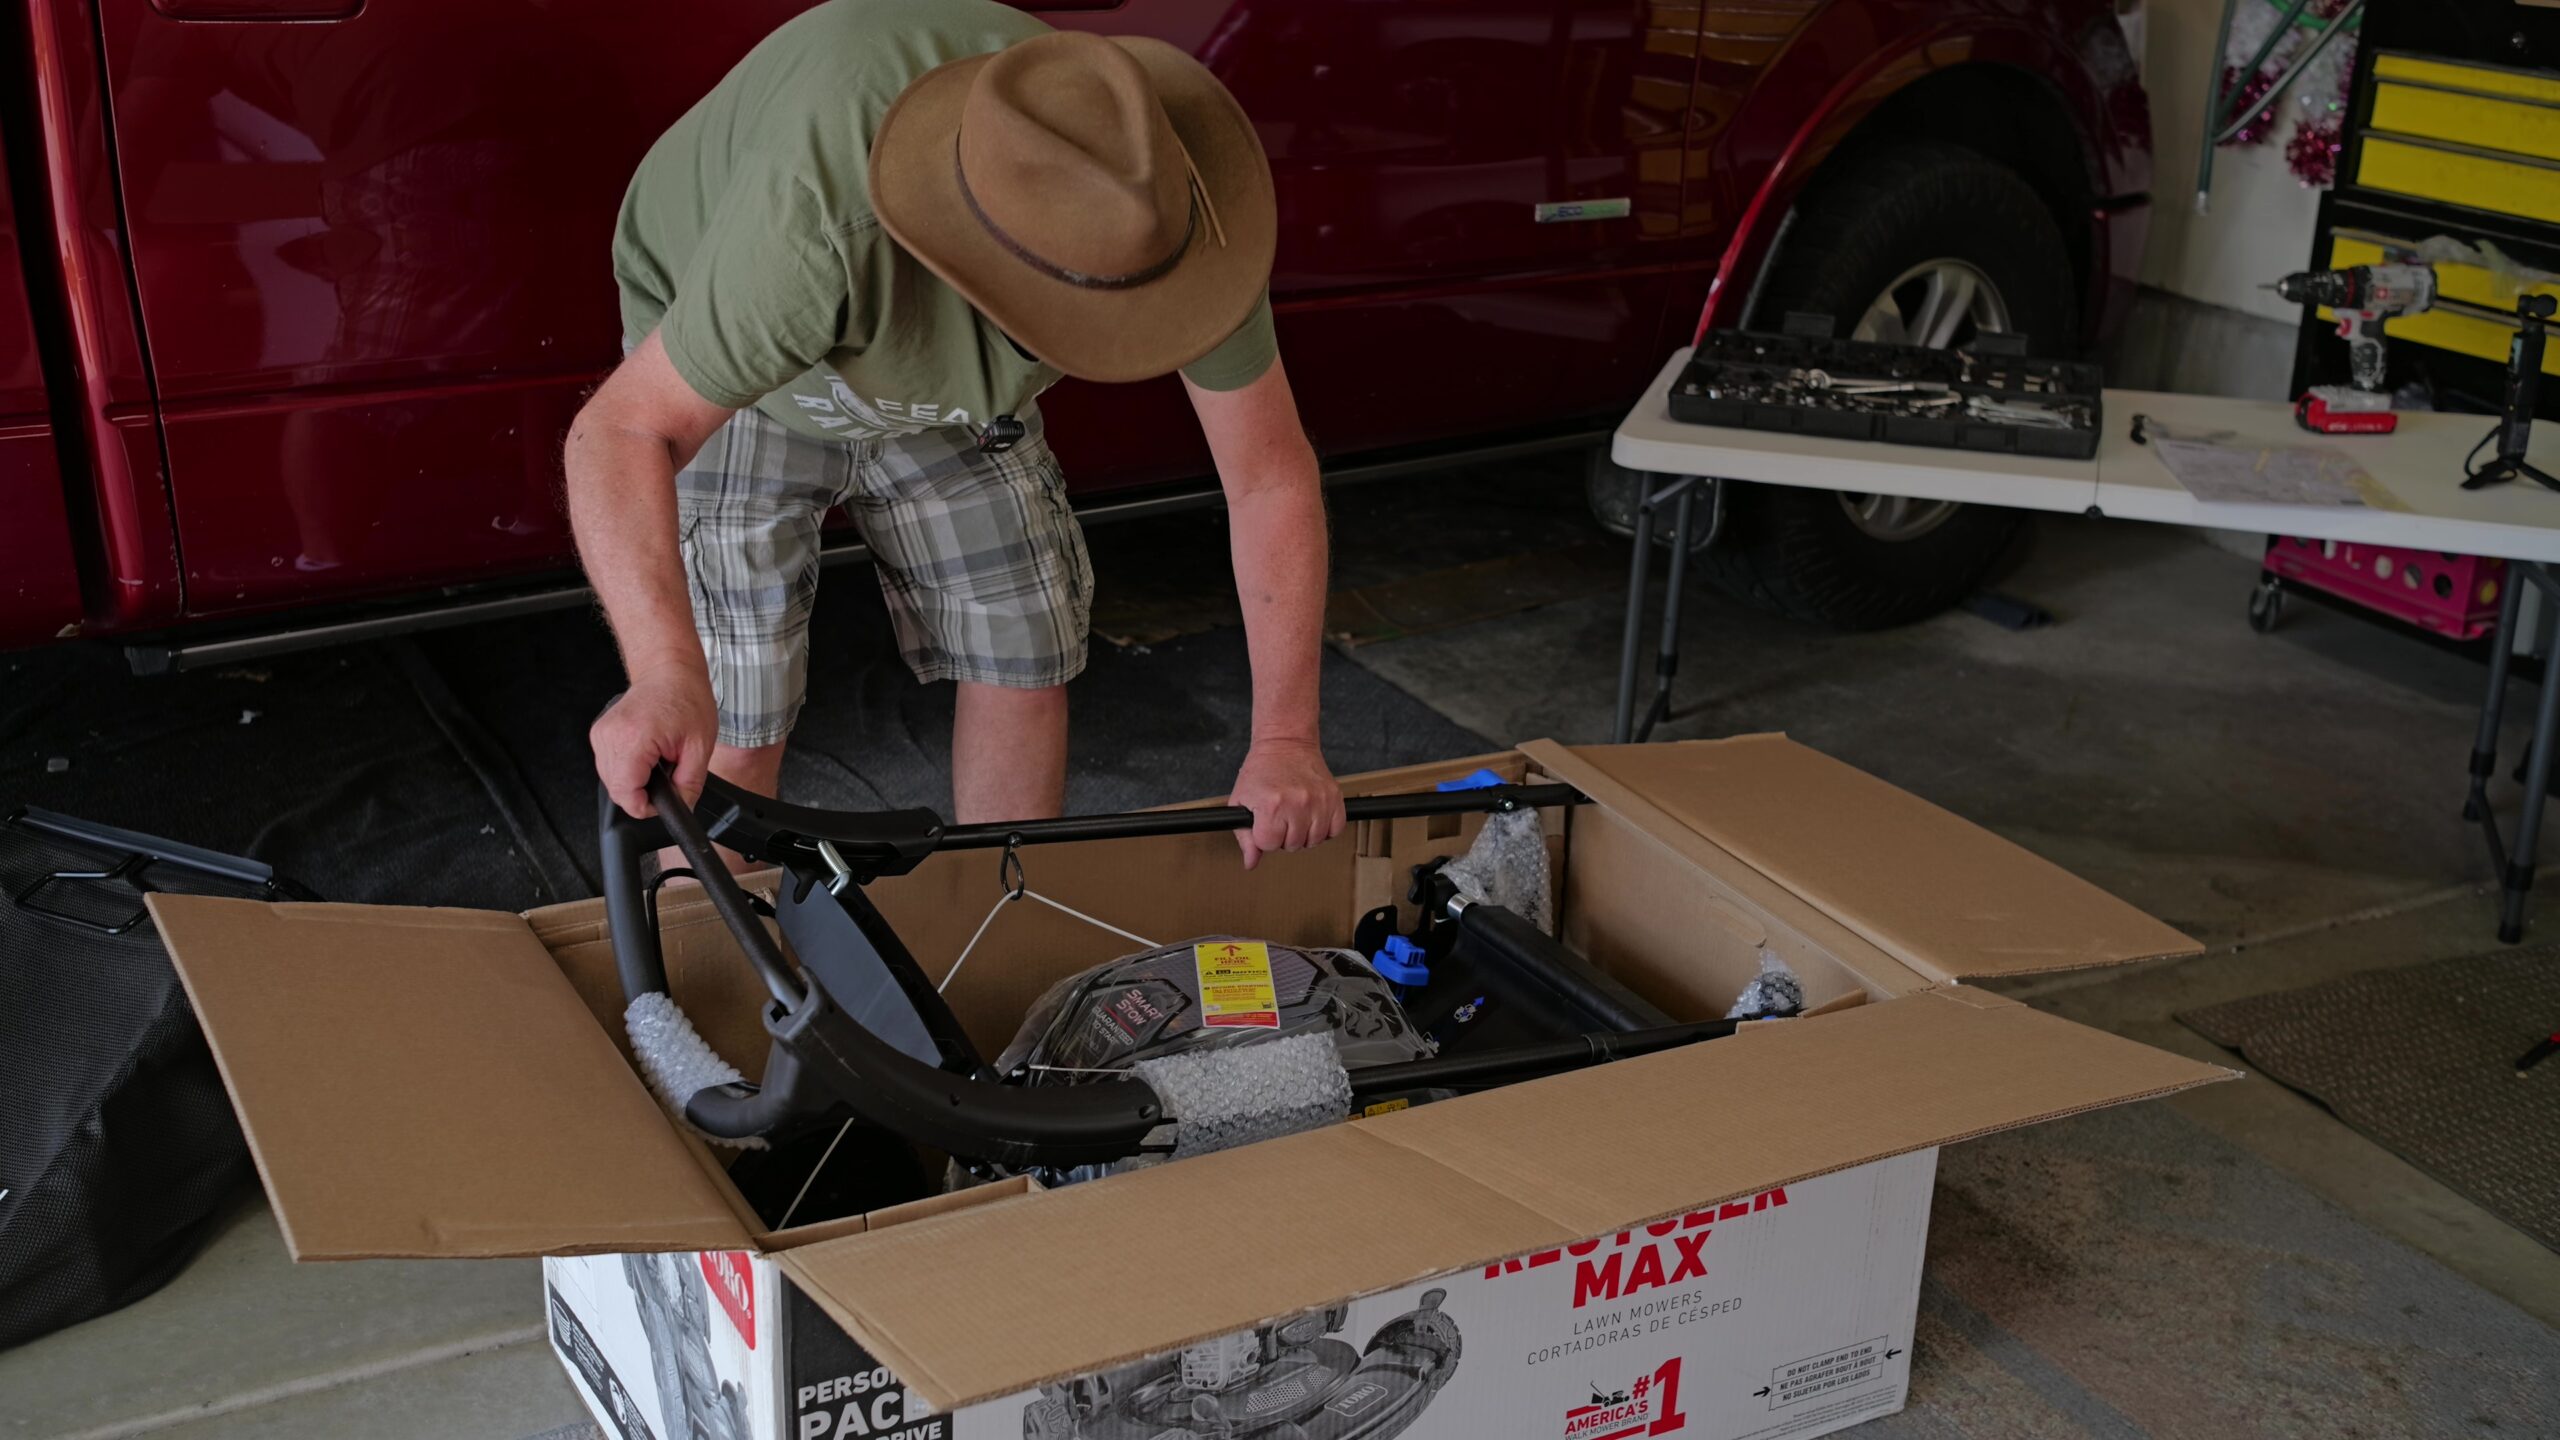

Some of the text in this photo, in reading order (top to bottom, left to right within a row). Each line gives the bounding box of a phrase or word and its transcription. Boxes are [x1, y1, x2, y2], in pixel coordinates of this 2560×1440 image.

[1116, 999, 1147, 1026] STOW
[1127, 989, 1164, 1020] SMART
[1092, 1005, 1135, 1046] GUARANTEED
[1099, 1027, 1120, 1045] START
[1572, 1229, 1712, 1308] MAX
[1574, 1290, 1703, 1335] LAWN MOWERS
[1527, 1297, 1743, 1365] CORTADORAS DE CÉSPED
[1780, 1381, 1788, 1391] NE
[1790, 1378, 1803, 1388] PAS
[1804, 1369, 1834, 1383] AGRAFER
[1835, 1364, 1852, 1374] BOUT
[1860, 1356, 1877, 1367] BOUT
[1787, 1346, 1873, 1377] DO NOT CLAMP END TO END
[1335, 1386, 1376, 1409] TORO
[1782, 1369, 1871, 1401] NO SUJETAR POR LOS LADOS
[1565, 1400, 1649, 1435] AMERICA'S
[1565, 1412, 1649, 1440] WALK MOWER BRAND
